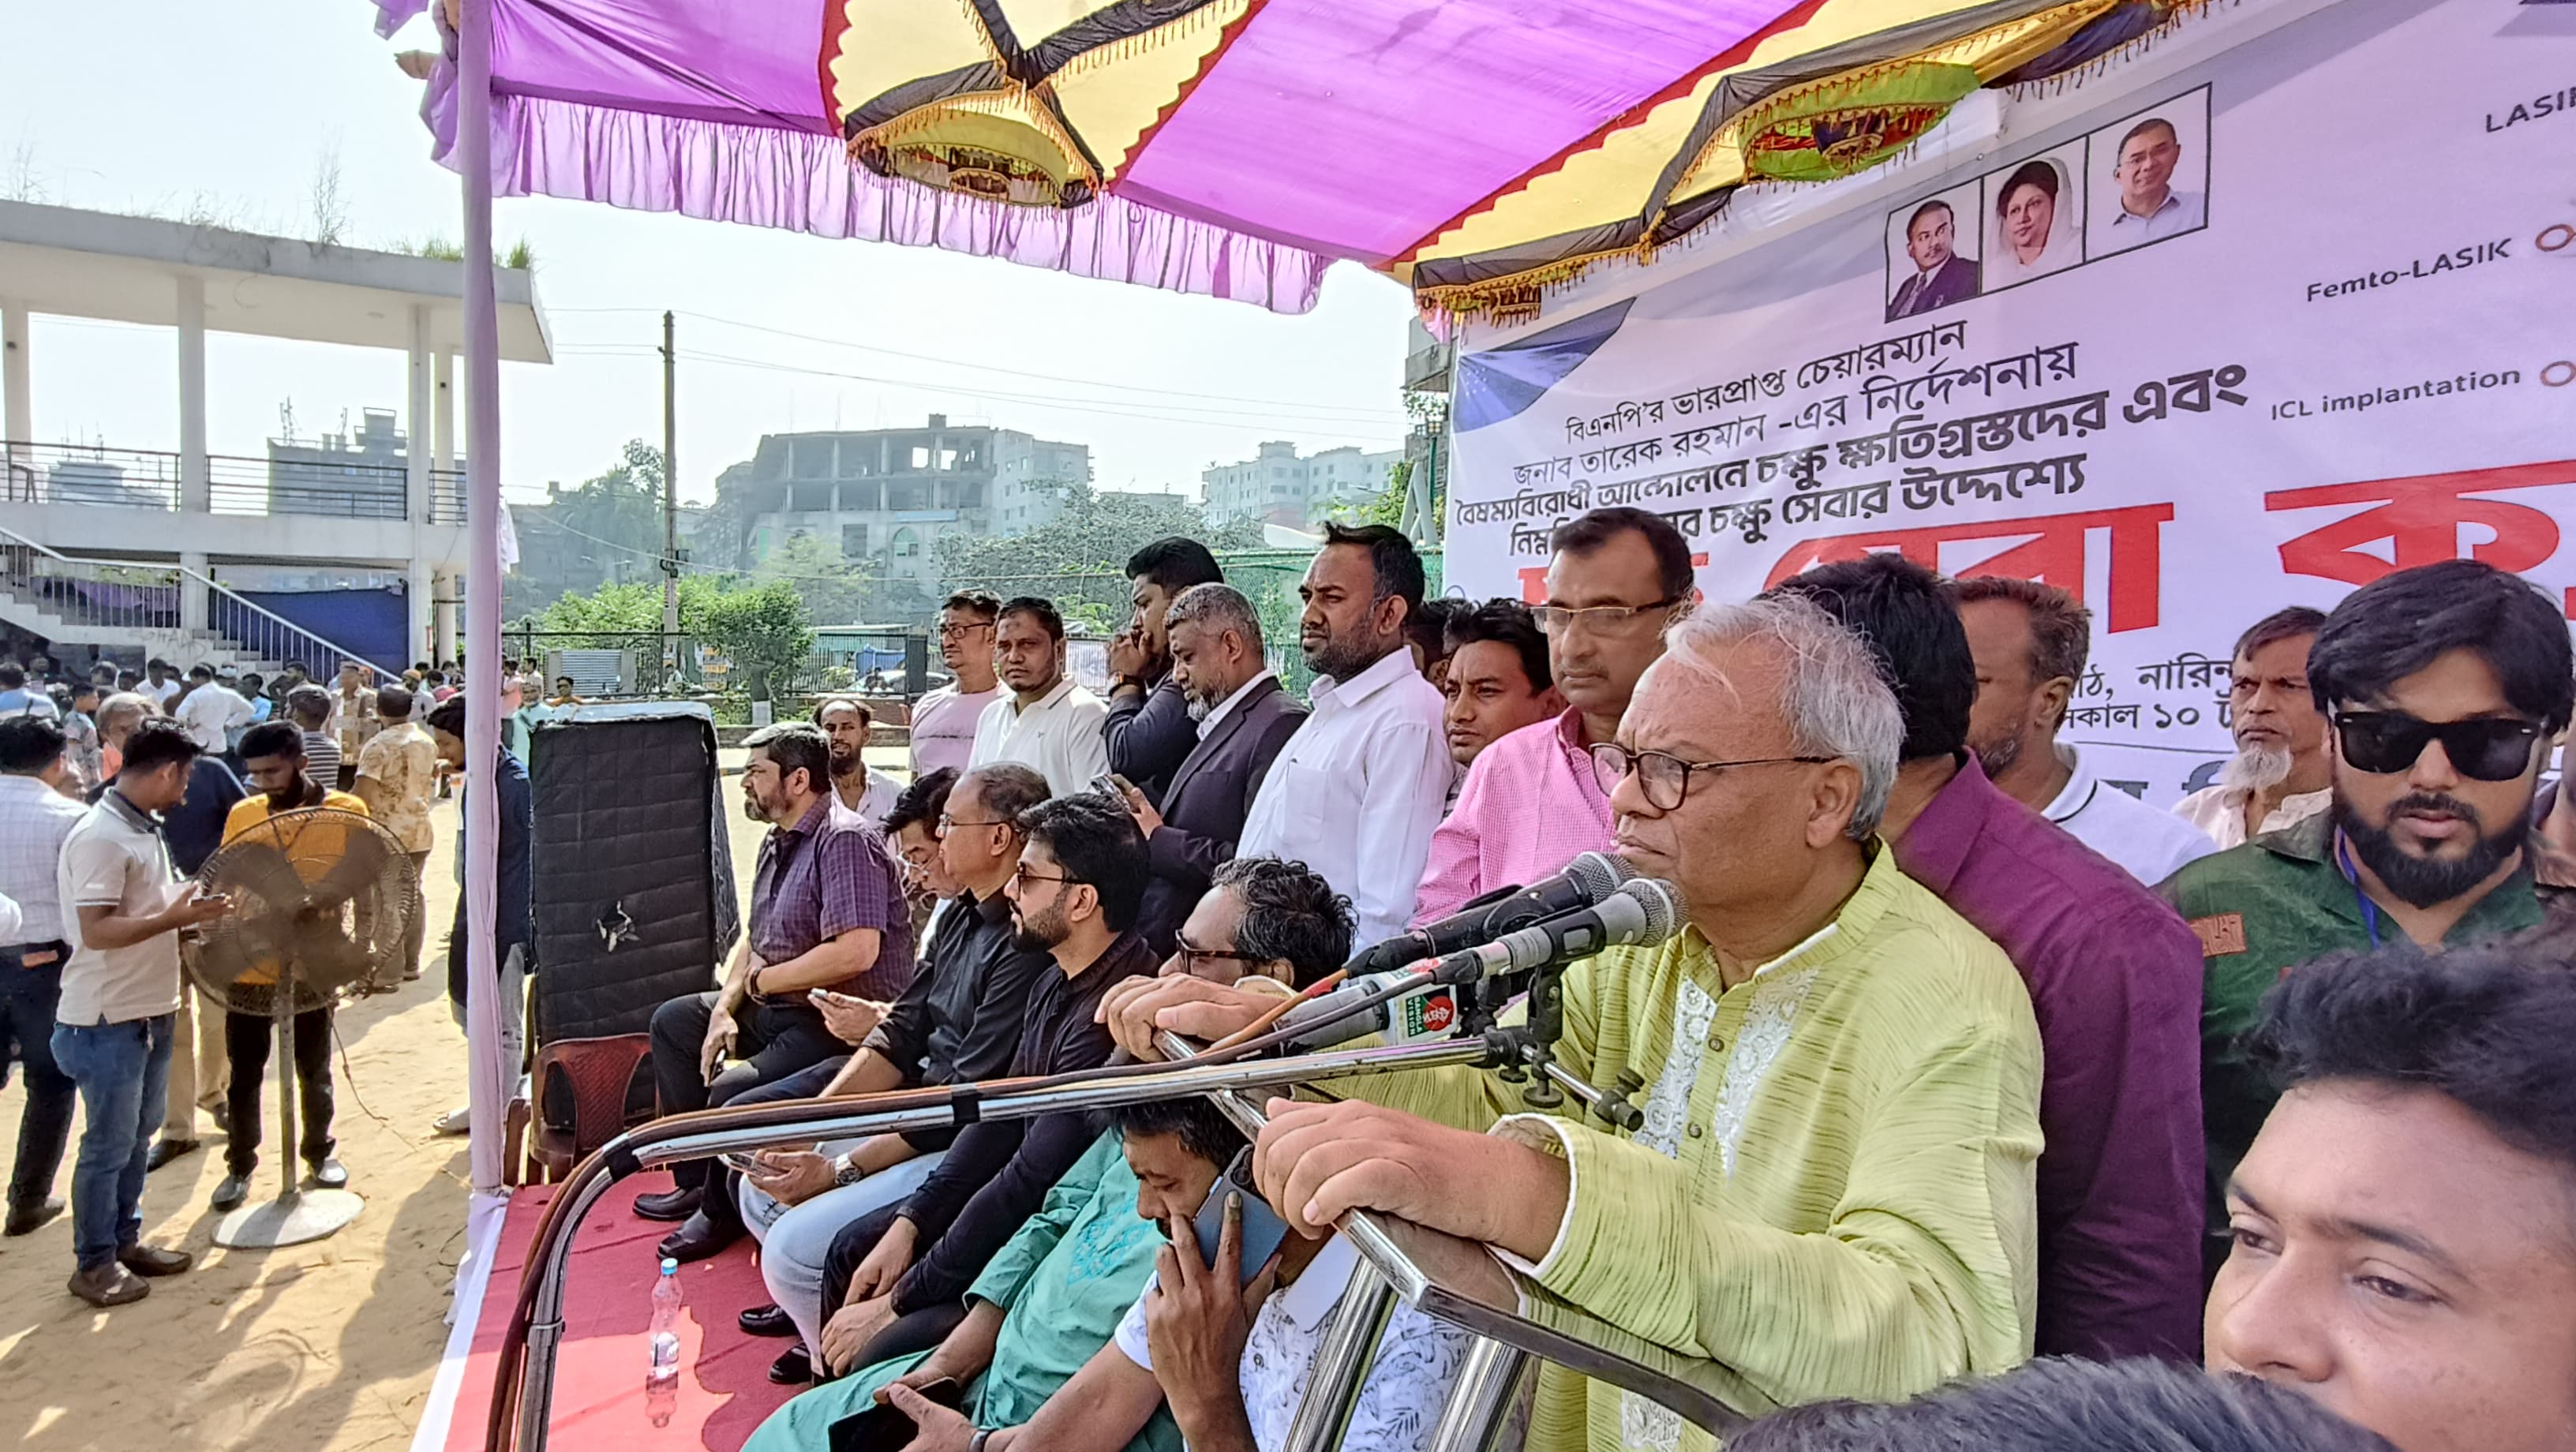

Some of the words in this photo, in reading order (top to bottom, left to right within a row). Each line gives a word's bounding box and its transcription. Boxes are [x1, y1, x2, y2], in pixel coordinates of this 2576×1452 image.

[2306, 238, 2513, 302] Femto-LASIK
[1670, 369, 1786, 415] ভারপ্রাপ্ত
[1796, 320, 1968, 389] চেয়ারম্যান
[2271, 400, 2314, 421] ICL
[2322, 369, 2521, 413] implantation
[1455, 480, 1593, 526] বৈষম্যবিরোধী
[1596, 458, 1750, 507] আন্দোলনে
[1755, 443, 1829, 491] চক্ষু
[1837, 389, 2110, 470] ক্ষতিগ্রস্তদের
[2122, 363, 2249, 425] এবং
[1513, 456, 1573, 487] জনাব
[1579, 437, 1663, 474] তারেক
[1669, 414, 1766, 457] রহমান
[1859, 341, 2079, 421] নির্দেশনায়
[1709, 498, 1773, 544] চক্ষু
[1782, 481, 1892, 525] সেবার
[1900, 453, 2087, 511] উদ্দেশ্যে
[2153, 704, 2200, 729] ১০
